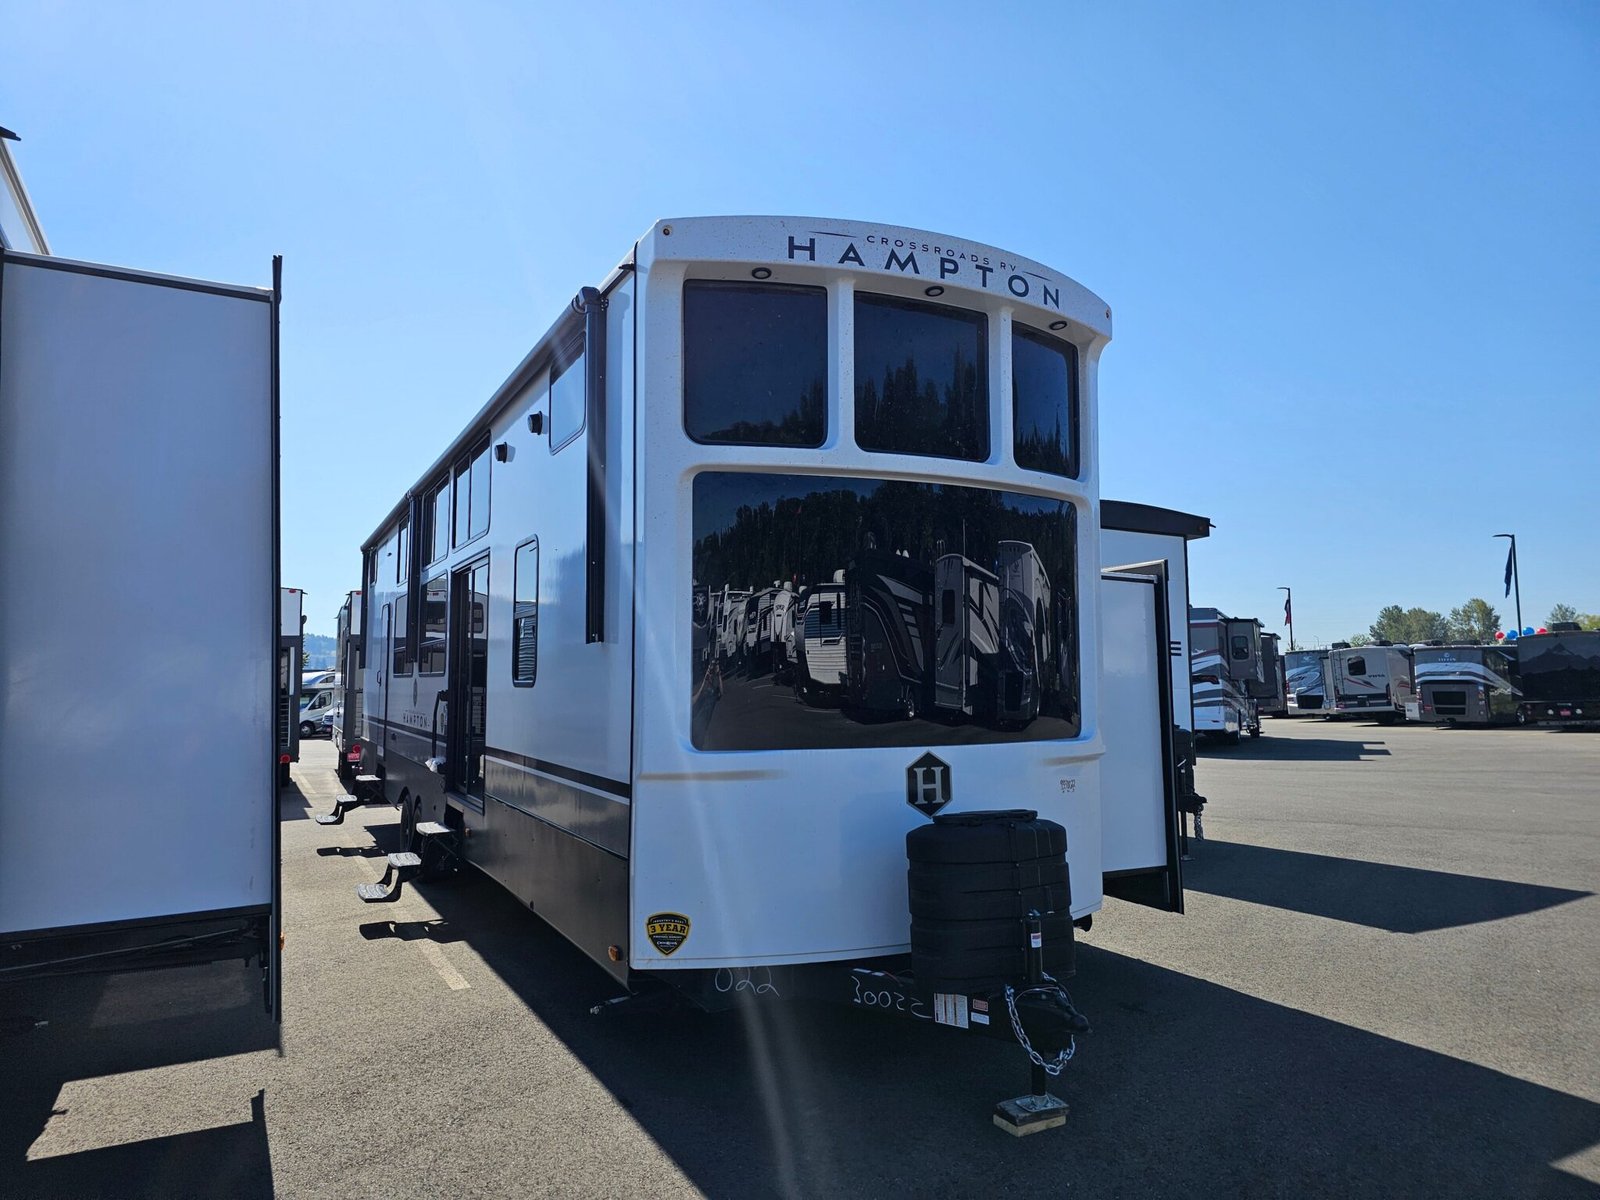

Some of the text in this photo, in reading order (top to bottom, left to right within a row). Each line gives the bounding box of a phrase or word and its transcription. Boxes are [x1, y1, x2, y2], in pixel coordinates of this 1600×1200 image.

[788, 235, 1060, 310] HAMPTON
[866, 235, 1017, 272] CROSSROADS RV
[913, 766, 946, 805] H
[650, 924, 686, 933] 3 YEAR
